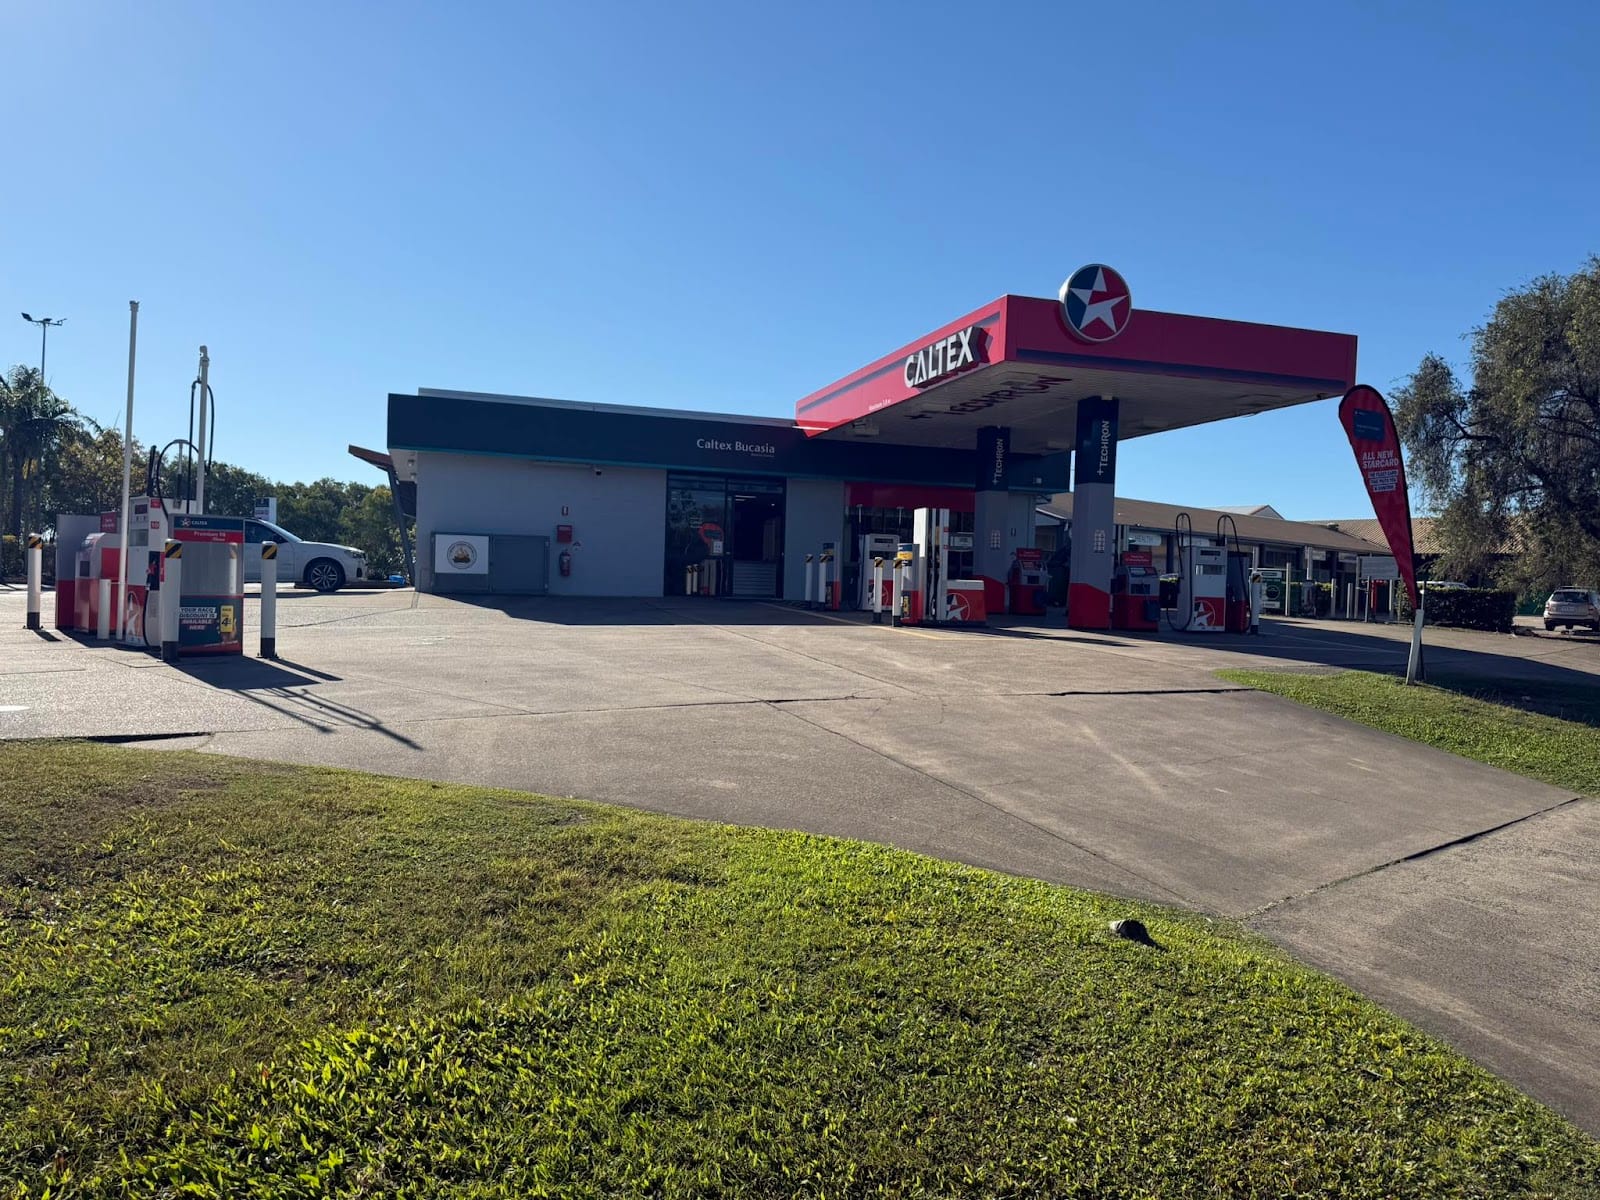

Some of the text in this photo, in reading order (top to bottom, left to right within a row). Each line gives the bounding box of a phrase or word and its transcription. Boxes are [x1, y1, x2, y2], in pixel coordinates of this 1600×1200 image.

[904, 326, 974, 388] CALTEX
[696, 438, 775, 454] Caltex Bucasia
[1363, 449, 1394, 460] ALL NEW
[1362, 458, 1399, 469] STARCARD
